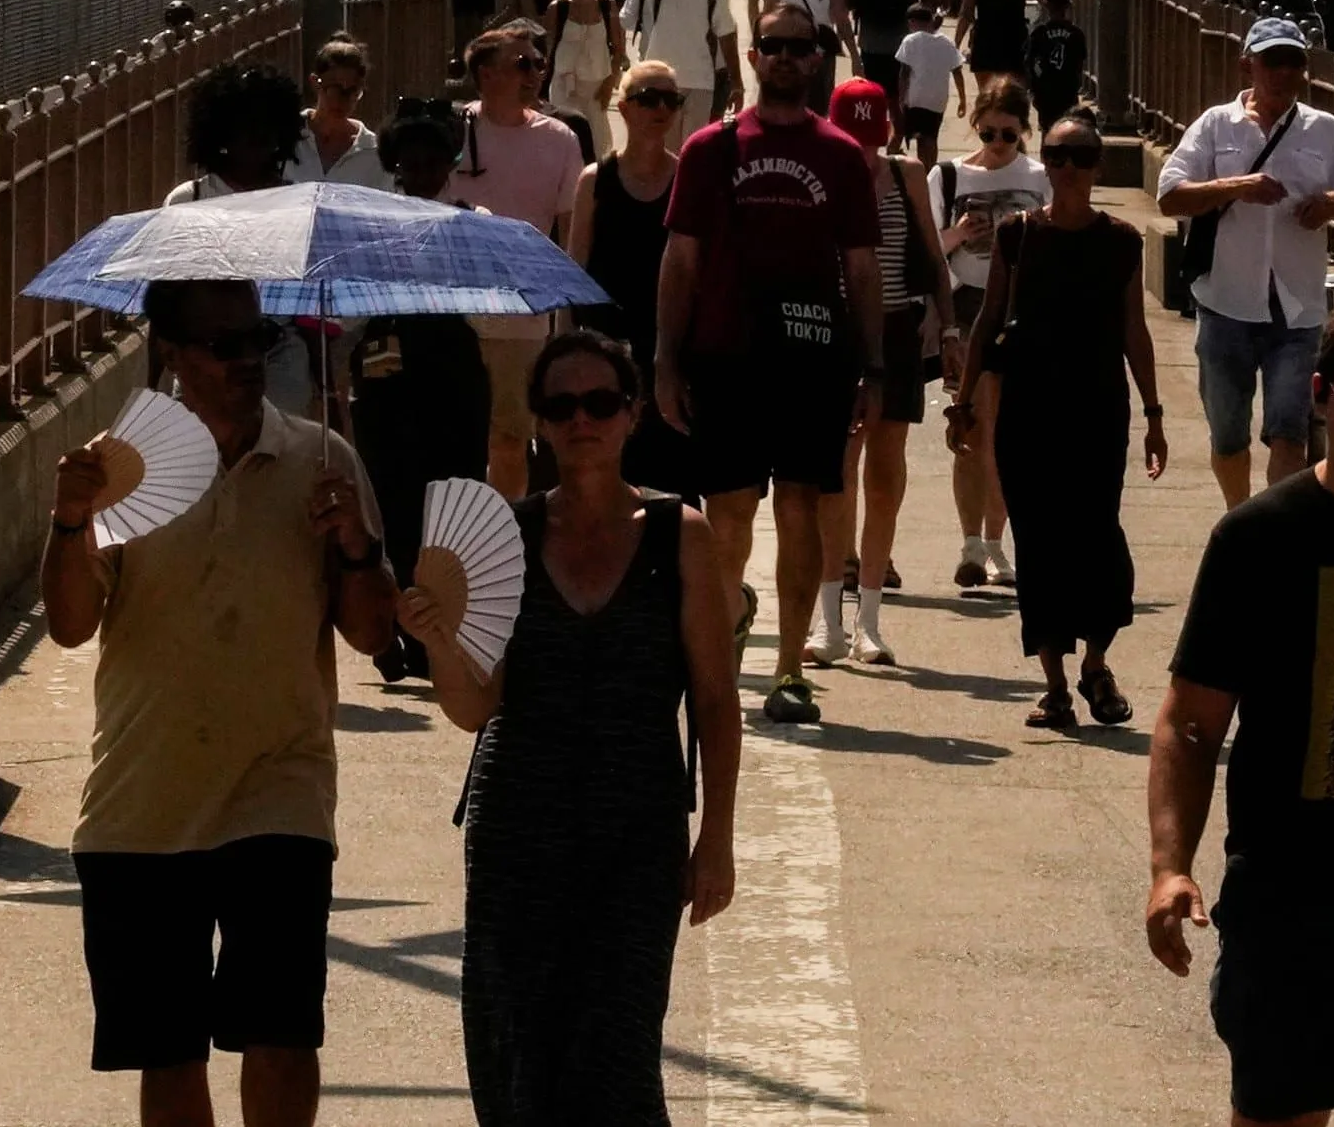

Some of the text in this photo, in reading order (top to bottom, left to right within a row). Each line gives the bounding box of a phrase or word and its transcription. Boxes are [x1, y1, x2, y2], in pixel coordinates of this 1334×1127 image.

[854, 101, 872, 121] NY
[781, 302, 832, 323] COACH
[785, 320, 832, 345] TOKYO
